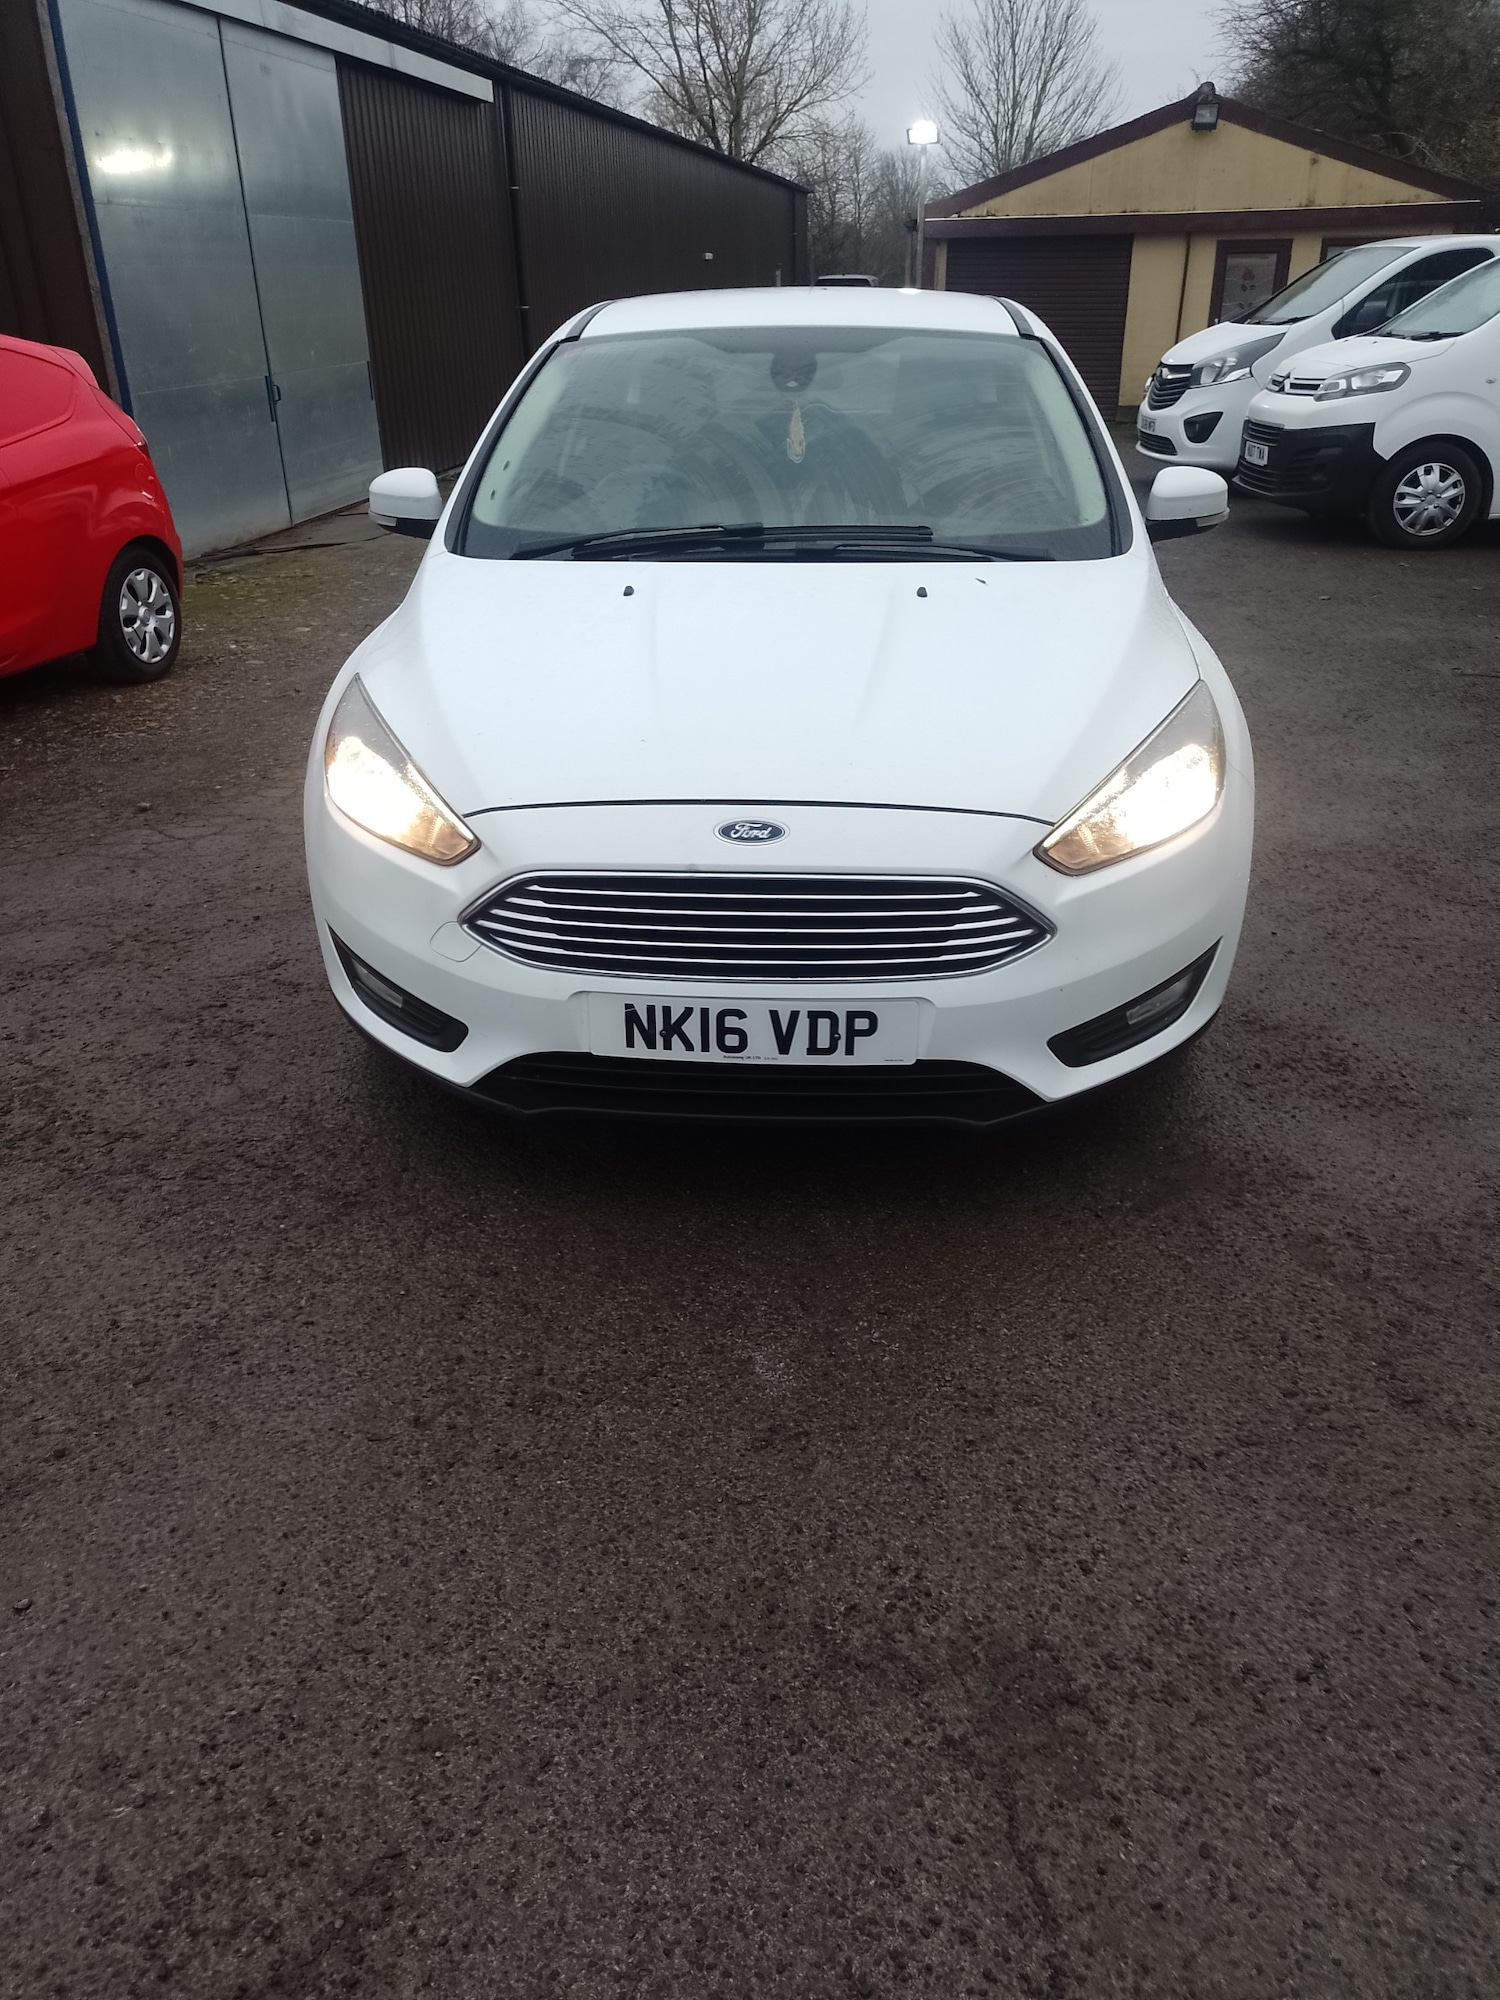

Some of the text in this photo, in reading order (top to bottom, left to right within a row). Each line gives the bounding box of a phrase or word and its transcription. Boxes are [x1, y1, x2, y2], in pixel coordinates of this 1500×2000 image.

[730, 822, 773, 839] Ford
[624, 1002, 879, 1057] NK16 VDP
